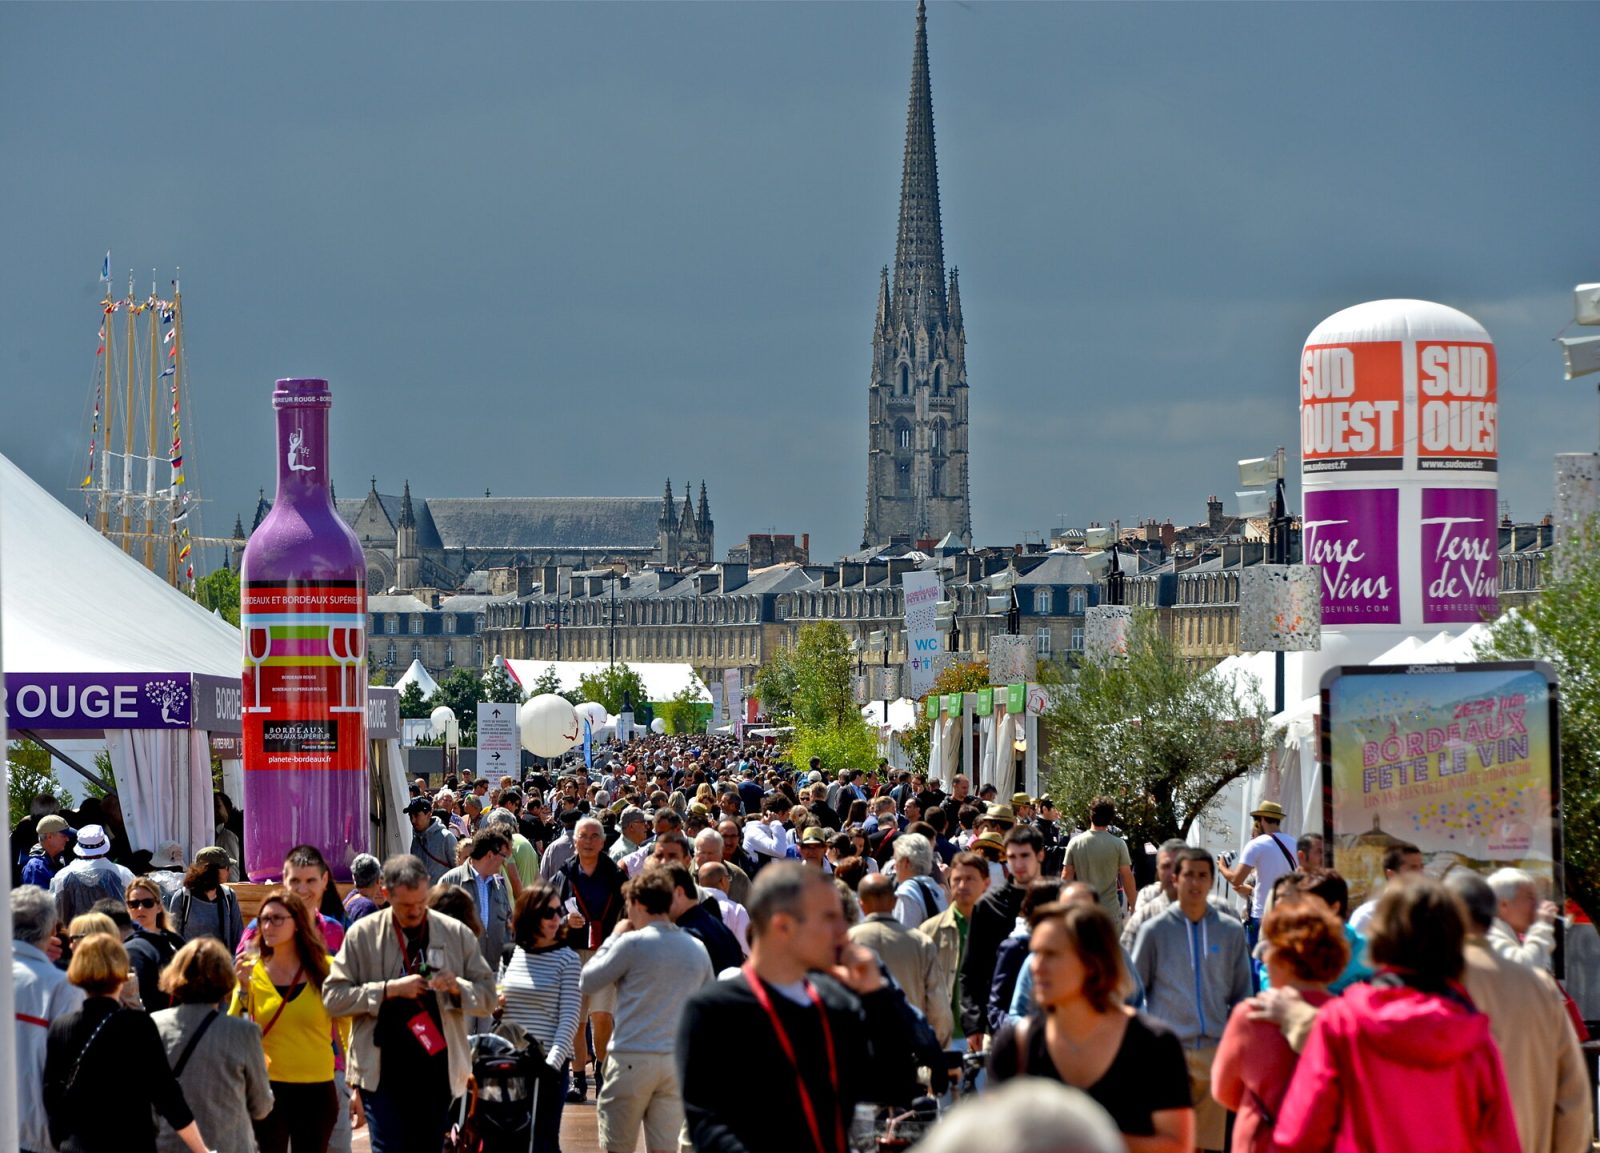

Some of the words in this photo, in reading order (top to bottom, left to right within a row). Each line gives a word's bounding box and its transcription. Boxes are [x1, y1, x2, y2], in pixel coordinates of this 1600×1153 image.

[1303, 347, 1355, 400] SUD
[1422, 345, 1488, 397] SUD
[1303, 401, 1399, 454] OUEST
[1421, 460, 1484, 469] www.sudouest.fr
[1304, 520, 1366, 566] Terre
[1421, 516, 1492, 563] Terre
[271, 596, 281, 604] ET
[282, 595, 329, 604] BORDEAUX
[1322, 558, 1392, 600] Vins
[1428, 561, 1462, 598] de
[915, 638, 937, 650] WC
[1406, 664, 1456, 674] JCDecaux
[1363, 710, 1528, 768] BORDEAUX
[1362, 756, 1429, 794] FETE
[1438, 748, 1467, 777] LE
[1476, 734, 1530, 768] VIN
